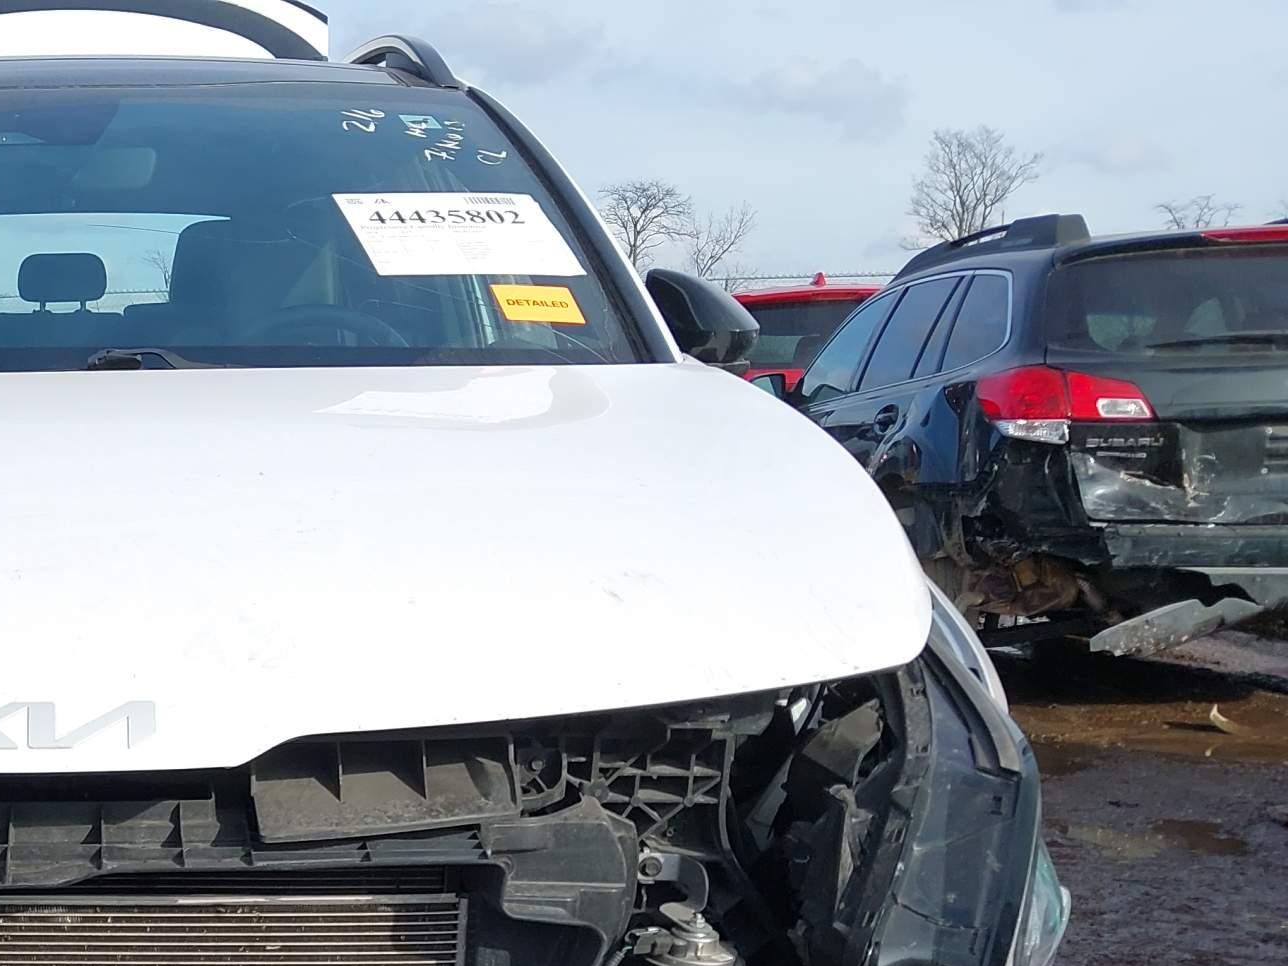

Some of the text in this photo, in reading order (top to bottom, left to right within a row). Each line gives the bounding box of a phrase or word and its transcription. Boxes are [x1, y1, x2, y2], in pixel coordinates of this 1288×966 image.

[369, 209, 526, 225] 44435802
[506, 297, 569, 310] DETAILED
[1085, 437, 1165, 448] SUBARU
